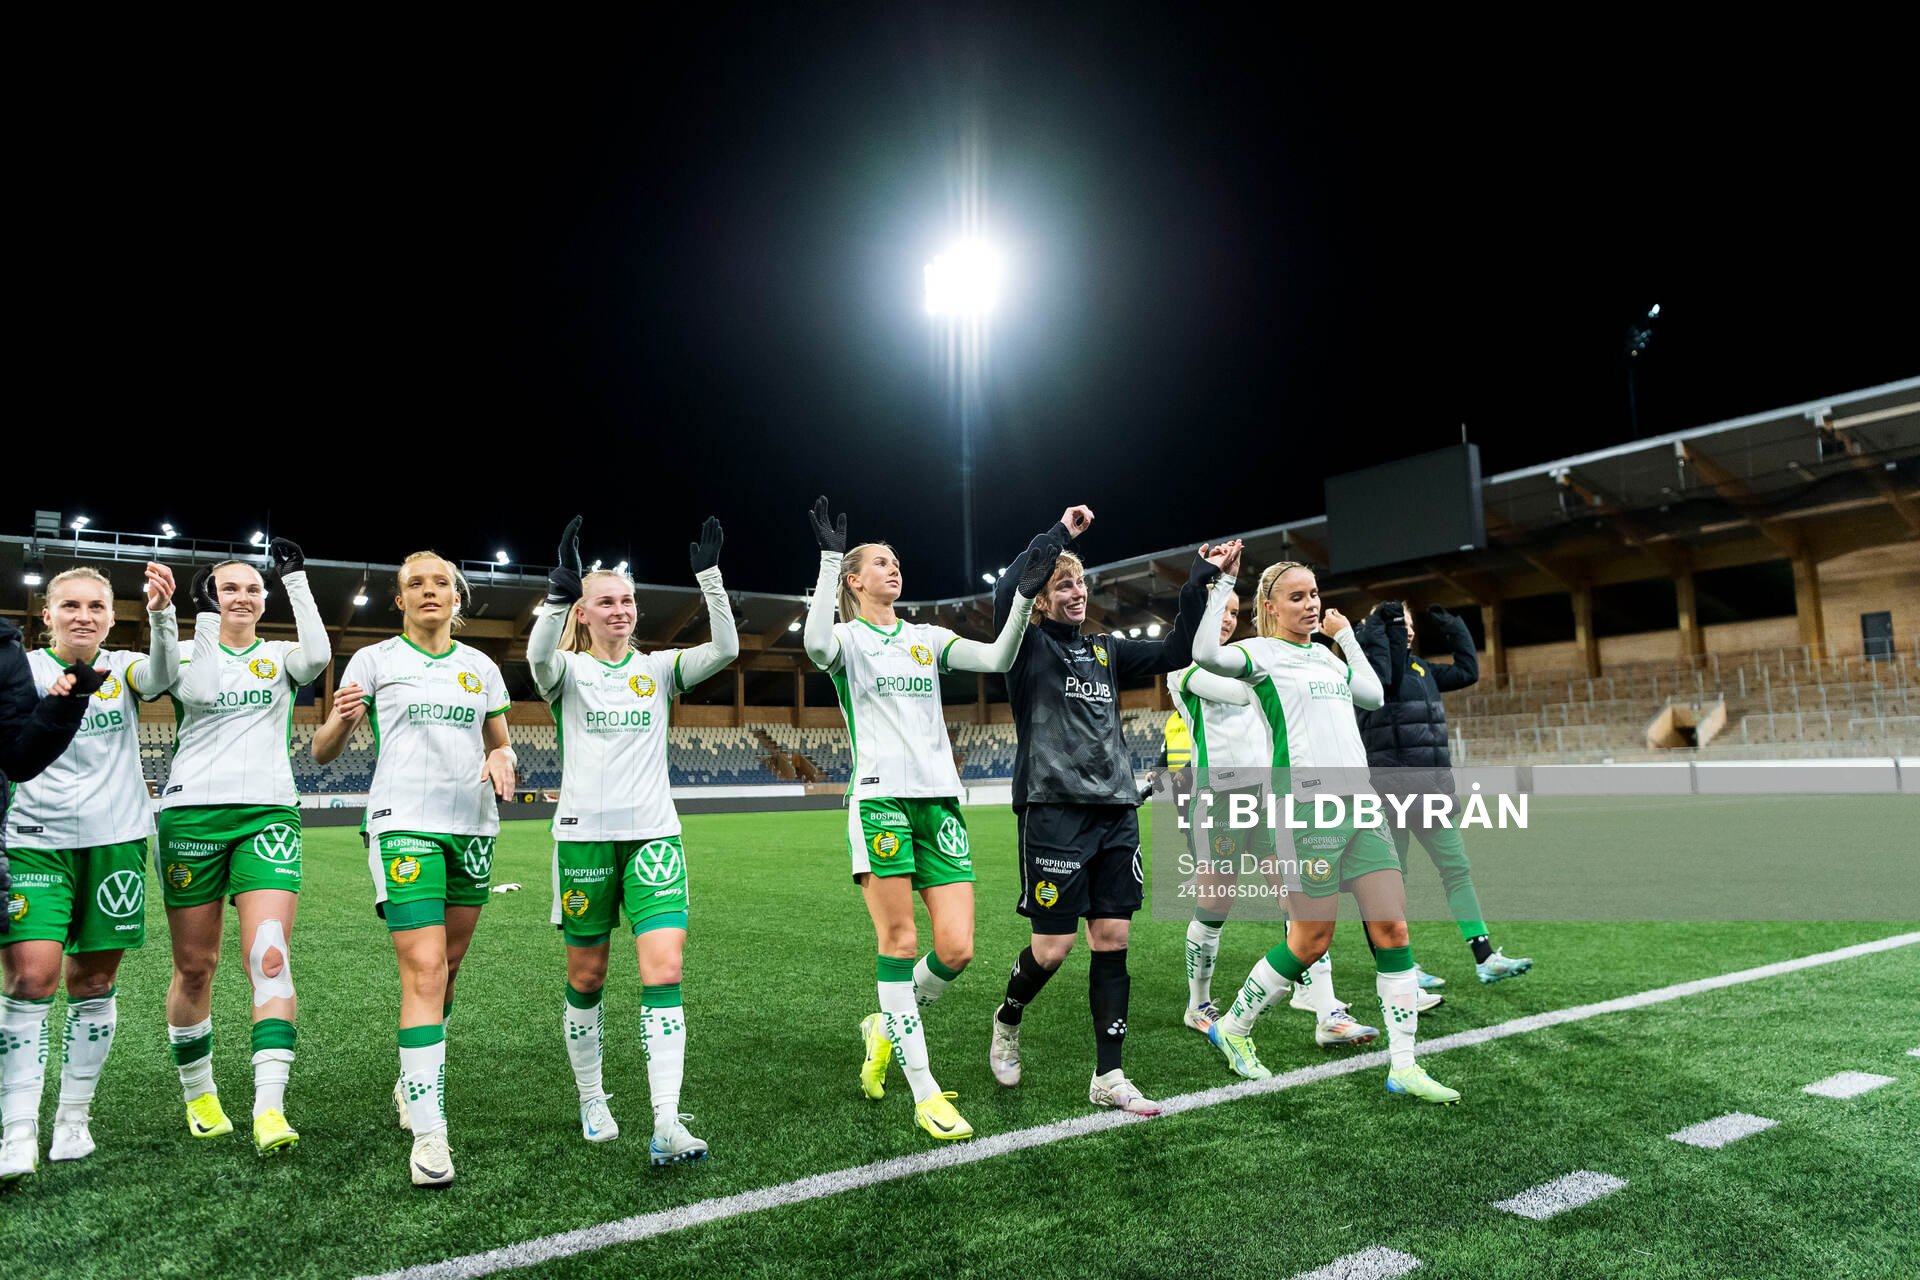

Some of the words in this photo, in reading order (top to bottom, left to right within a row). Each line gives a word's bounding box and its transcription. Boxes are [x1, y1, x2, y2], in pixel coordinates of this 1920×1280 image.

[876, 676, 933, 692] PROJOB
[214, 690, 273, 707] ROJOB
[408, 703, 476, 722] PROJOB
[586, 710, 651, 727] PROJOB
[870, 812, 905, 820] BOSPHO
[168, 841, 227, 851] BOSPHORUS
[1035, 856, 1081, 869] BOSPHORUS
[11, 873, 63, 883] SPHORUS
[564, 867, 614, 877] BOSPHORUS
